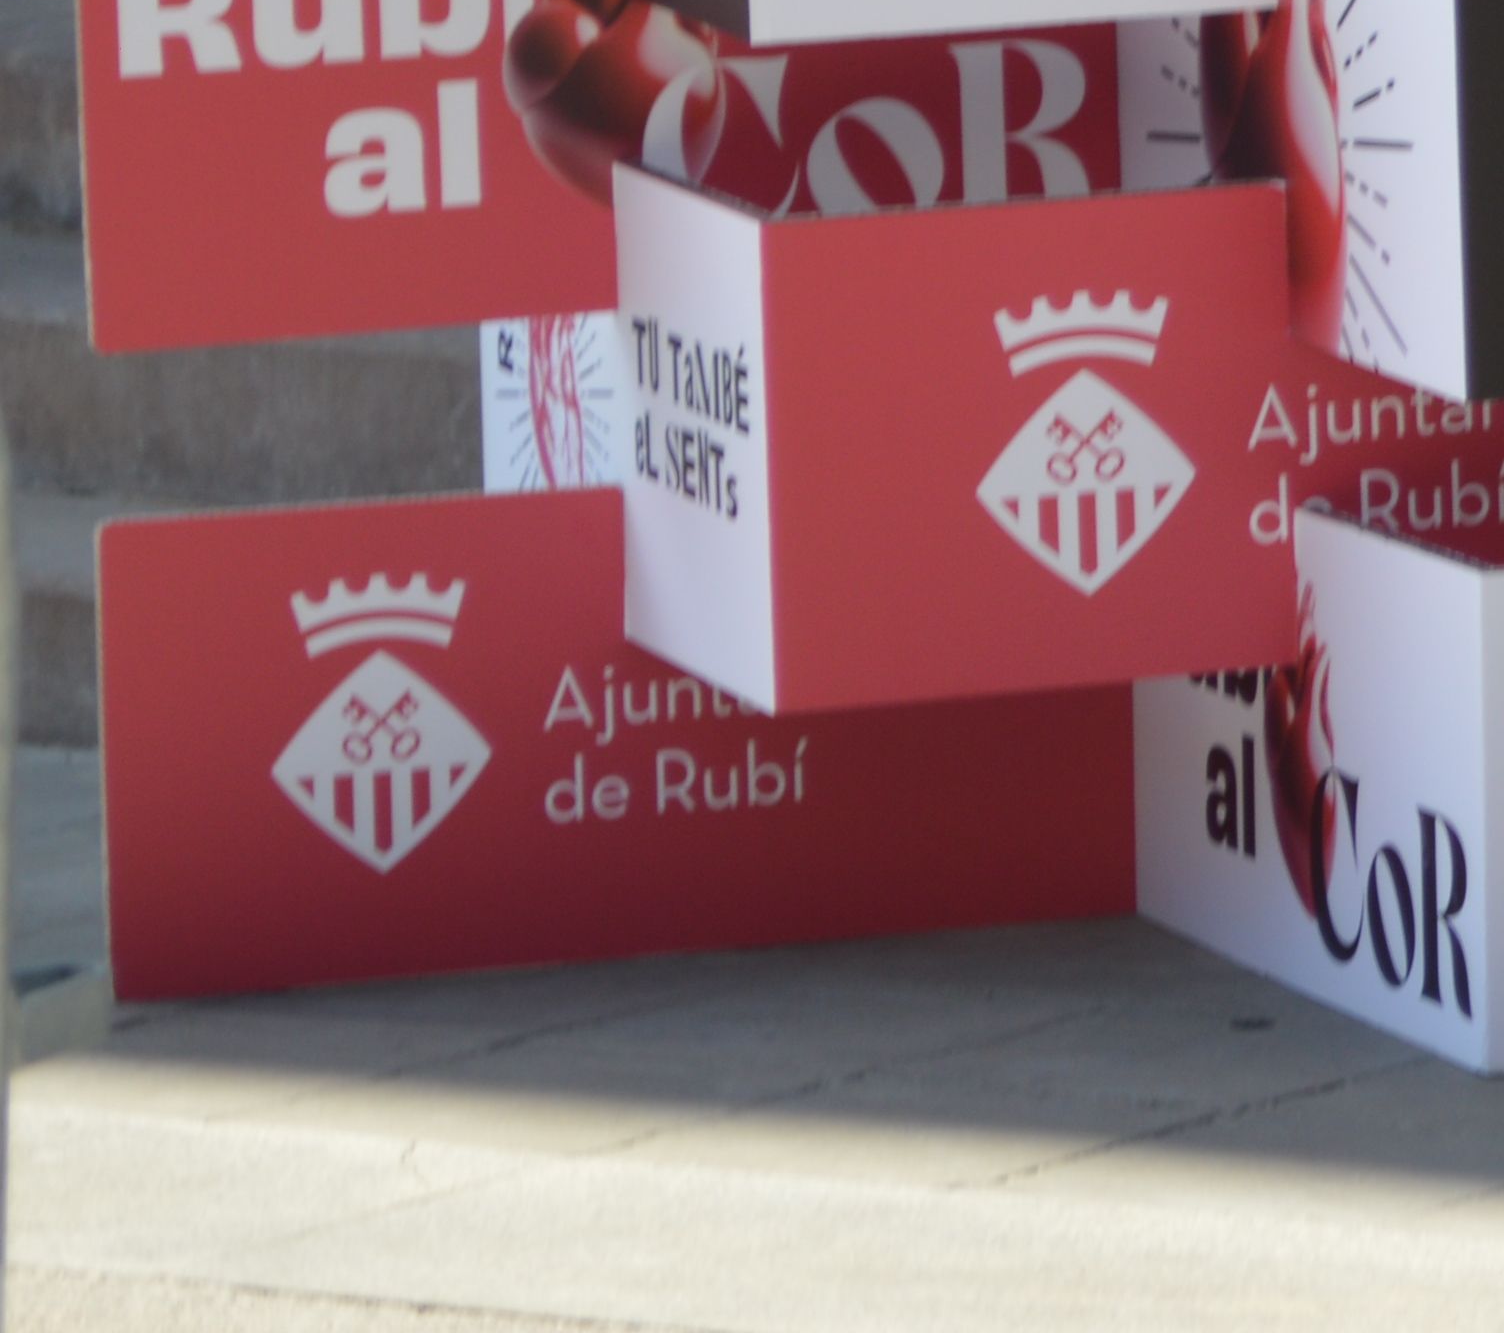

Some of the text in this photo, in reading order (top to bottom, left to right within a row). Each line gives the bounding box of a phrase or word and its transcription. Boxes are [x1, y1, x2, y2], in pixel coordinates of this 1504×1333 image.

[323, 79, 483, 218] al
[632, 317, 660, 394] TU
[544, 735, 808, 825] de Rubí
[1205, 732, 1256, 863] al
